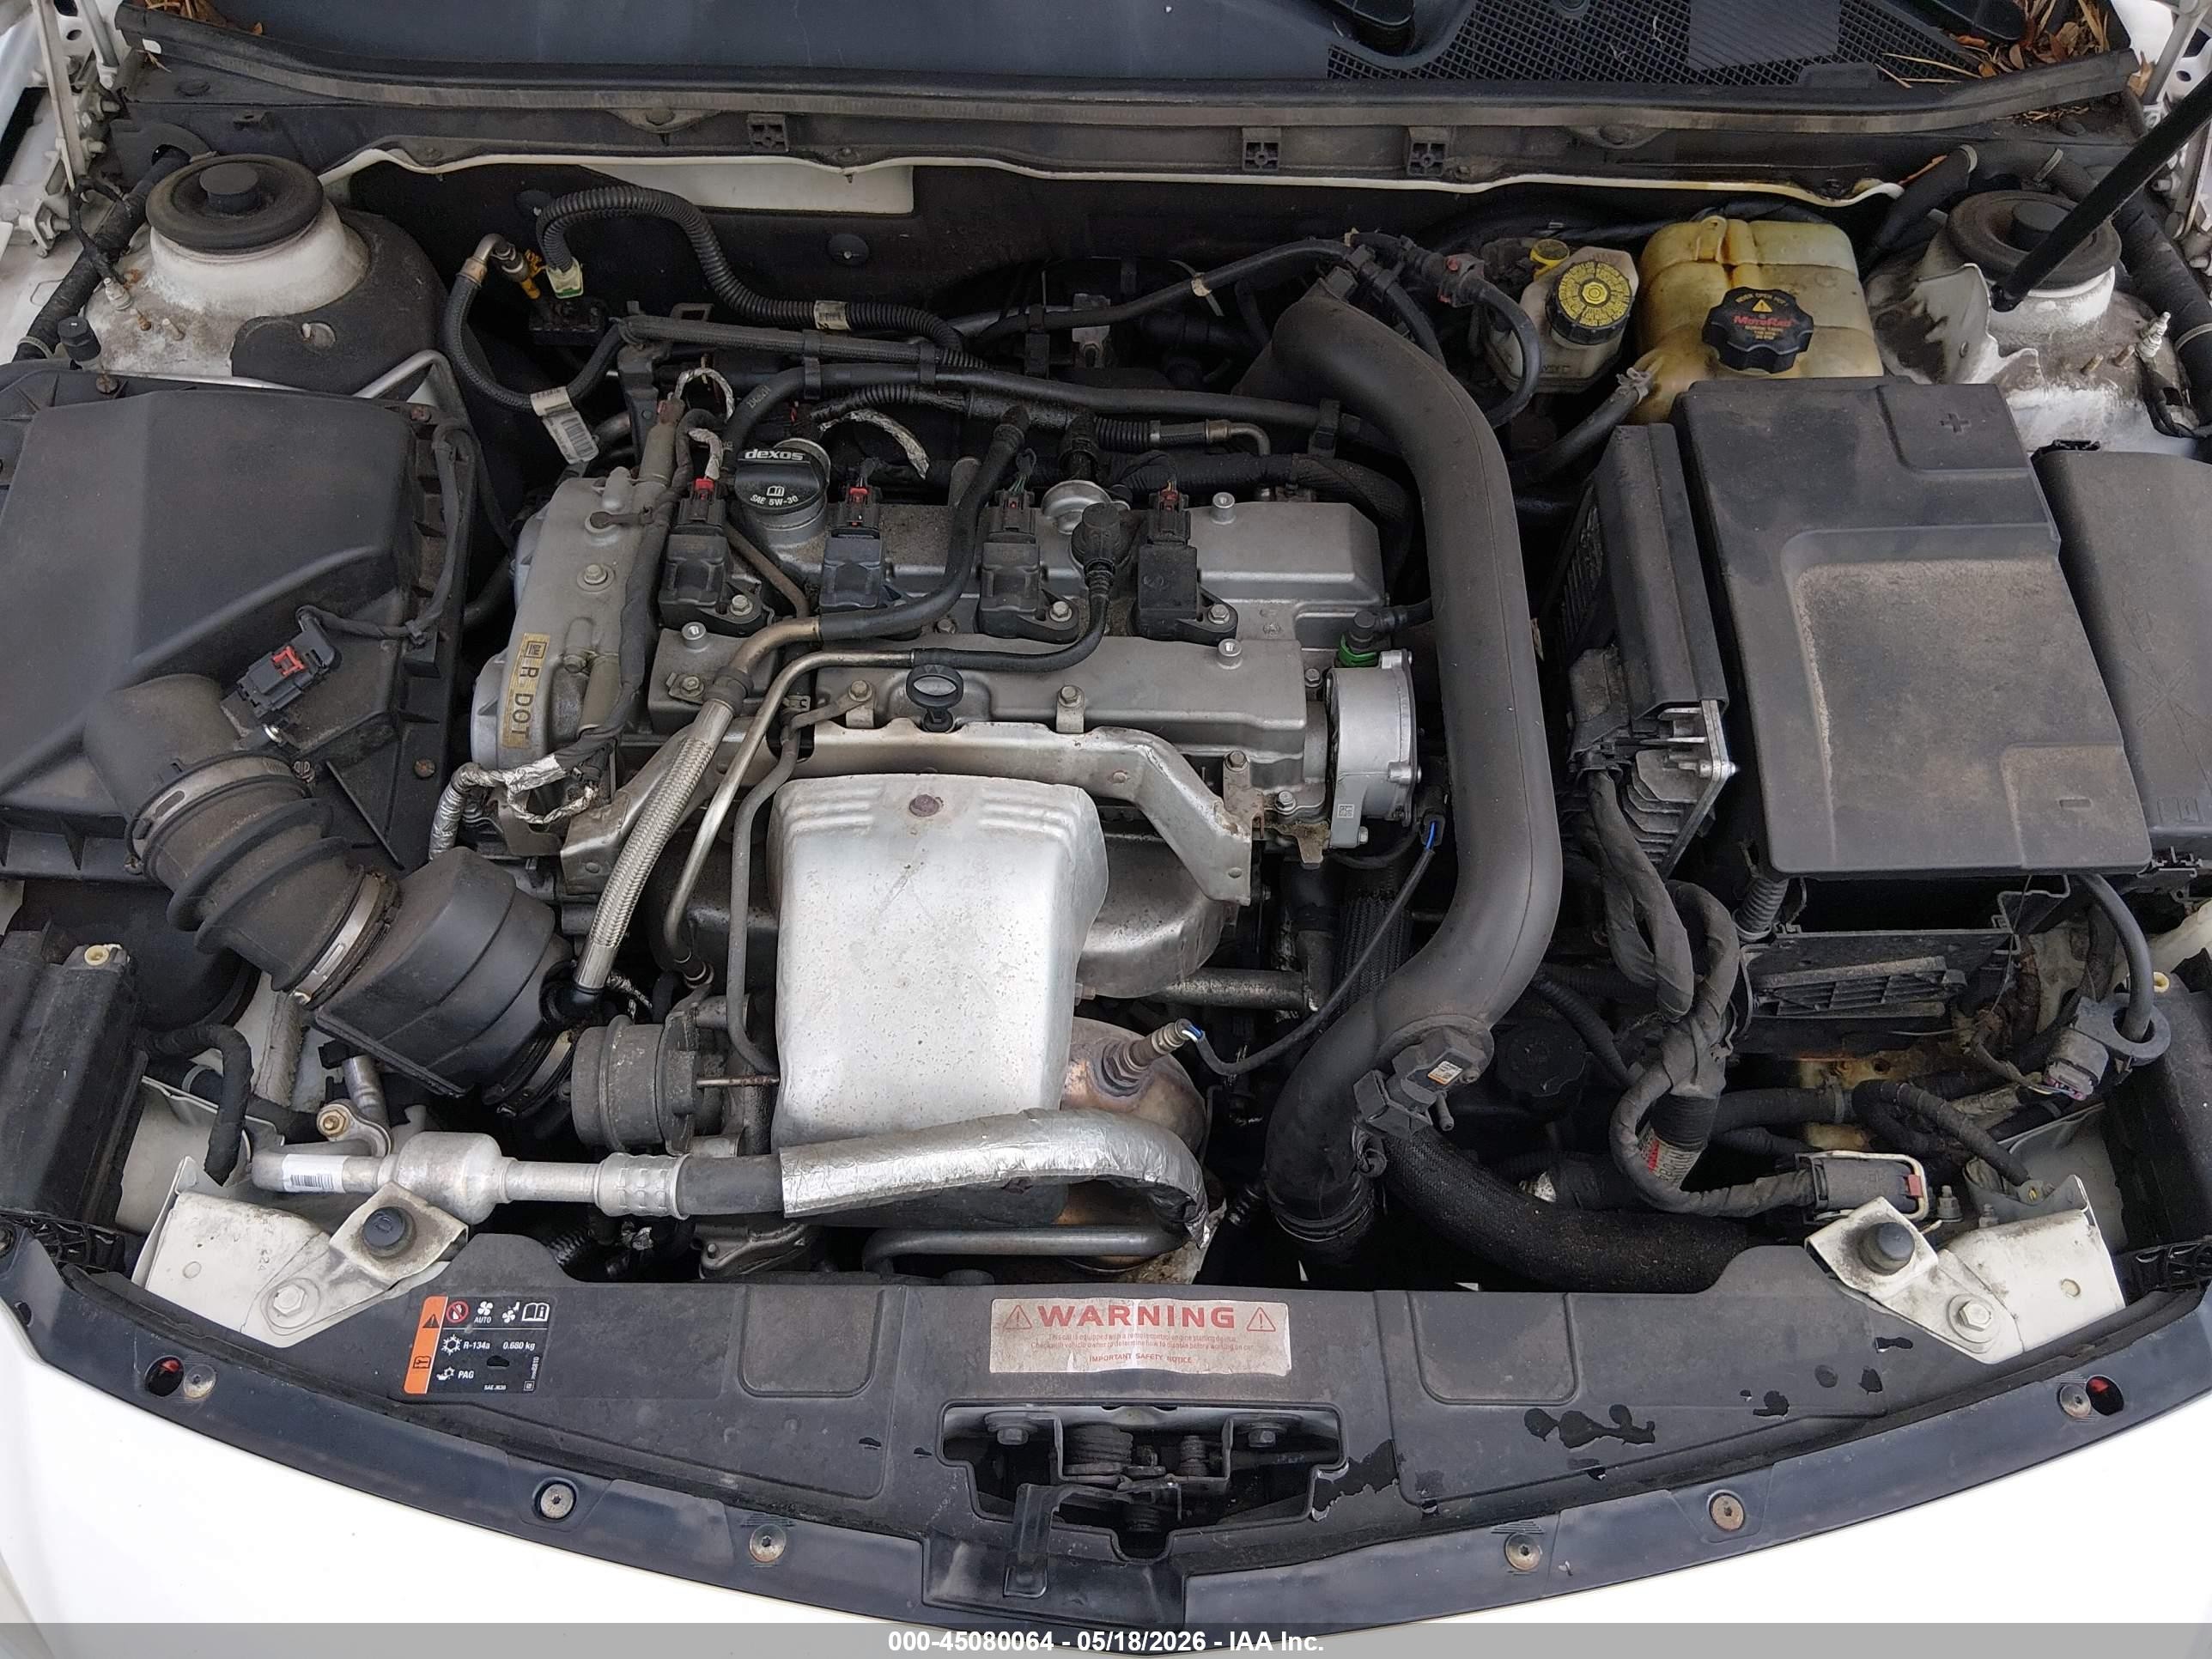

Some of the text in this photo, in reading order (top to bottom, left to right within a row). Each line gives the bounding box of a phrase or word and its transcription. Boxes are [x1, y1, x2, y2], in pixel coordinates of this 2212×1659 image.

[744, 448, 805, 461] dexos
[750, 494, 799, 506] SAE 5W-30
[1037, 1304, 1235, 1328] WARNING
[1079, 1333, 1108, 1342] equipped
[1193, 1334, 1215, 1343] starting
[463, 1340, 536, 1351] R-134a 0.680 kg
[1089, 1352, 1192, 1364] IMPORTANT SAFETY NOTICE
[458, 1370, 474, 1379] PAG
